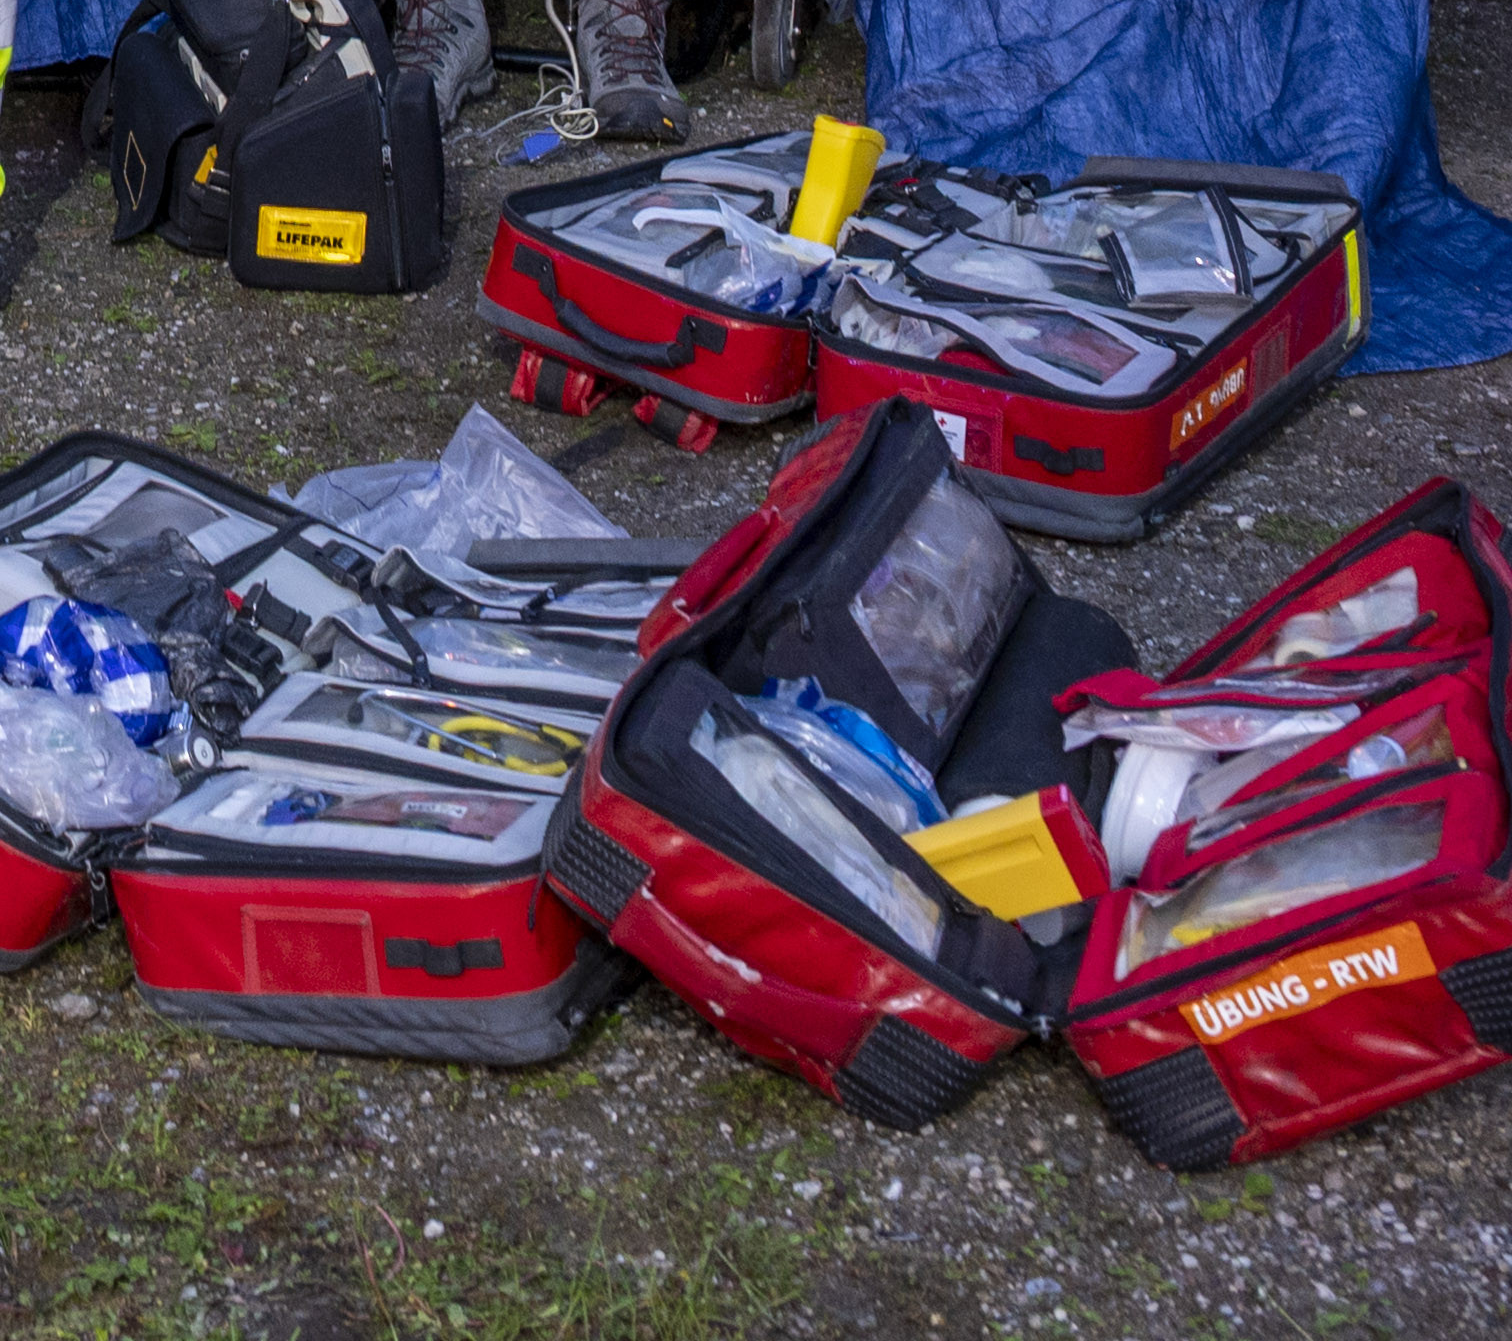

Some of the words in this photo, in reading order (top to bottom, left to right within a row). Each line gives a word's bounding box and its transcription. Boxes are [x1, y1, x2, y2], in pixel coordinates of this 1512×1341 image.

[276, 231, 344, 249] LIFEPAK
[1190, 973, 1311, 1038] ÜBUNG
[1327, 944, 1400, 989] RTW
